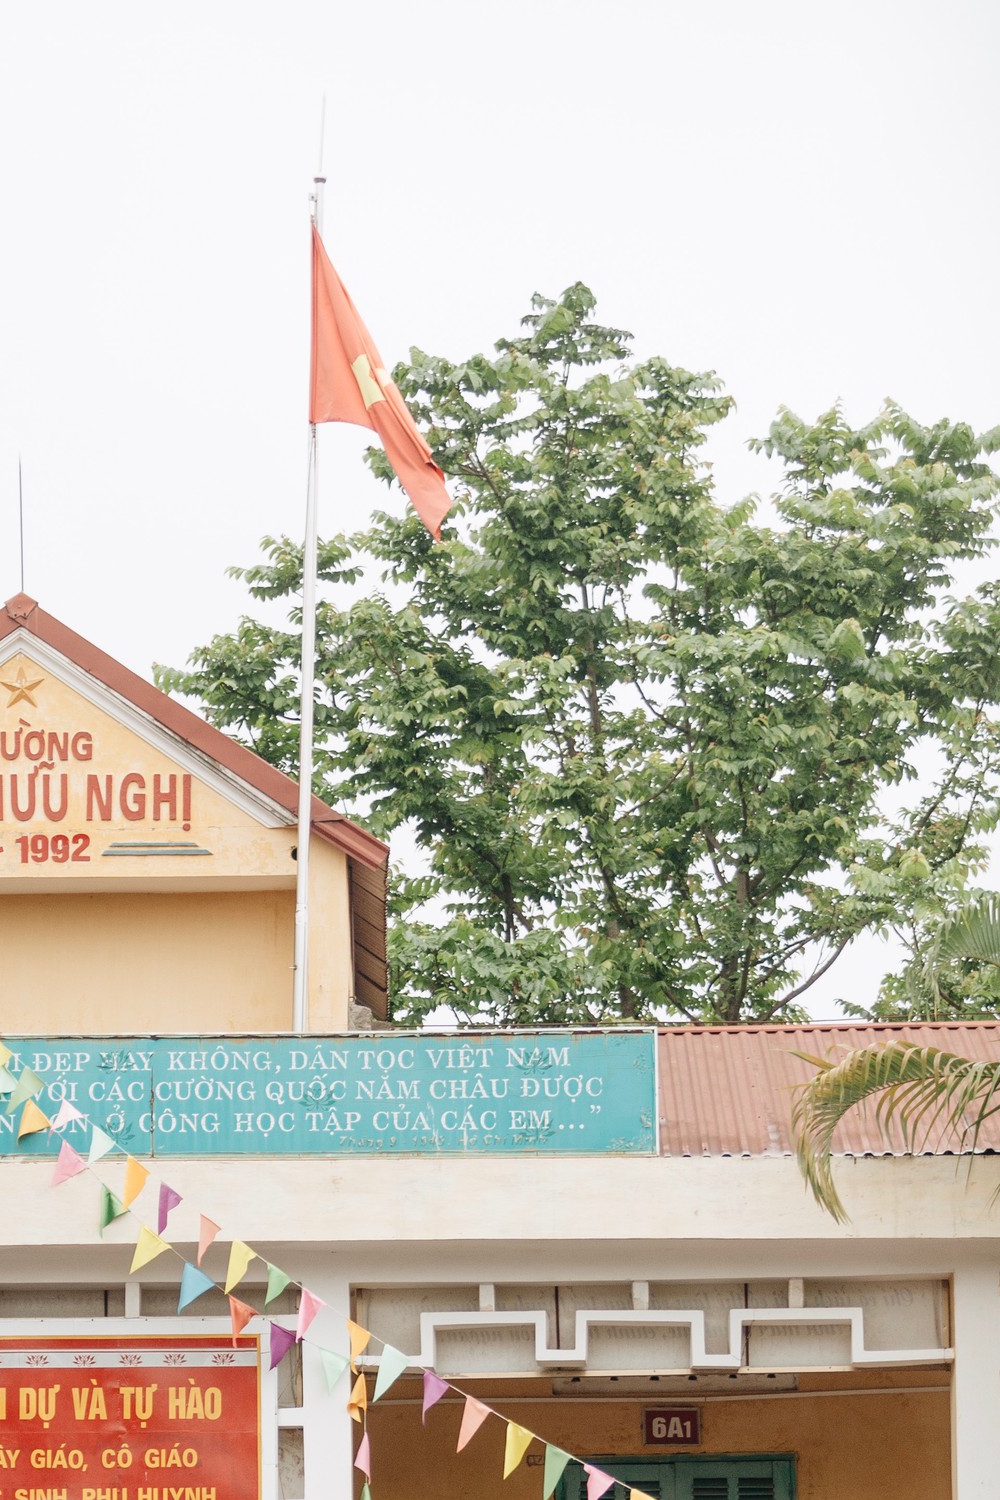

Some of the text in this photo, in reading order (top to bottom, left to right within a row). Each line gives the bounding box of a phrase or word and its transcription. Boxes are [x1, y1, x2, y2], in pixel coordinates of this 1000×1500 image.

[86, 773, 192, 831] NGHỊ
[32, 1052, 91, 1075] ĐẸP
[100, 1051, 154, 1072] HAY
[167, 1045, 281, 1074] KHÔNG,
[426, 1043, 494, 1074] VIỆT
[505, 1047, 571, 1068] NAM
[88, 1076, 145, 1102] CÁC
[155, 1075, 256, 1101] CƯỜNG
[265, 1073, 346, 1104] QUỐC
[355, 1075, 420, 1100] NĂM
[429, 1073, 509, 1100] CHÂU
[520, 1074, 603, 1103] ĐƯỢC
[139, 1108, 220, 1133] CÔNG
[234, 1112, 295, 1138] HỌC
[306, 1107, 362, 1136] TẬP
[373, 1104, 430, 1130] CỦA
[441, 1104, 497, 1130] CÁC
[19, 1384, 60, 1428] DỰ
[72, 1379, 107, 1420] VÀ
[120, 1384, 157, 1428] TỰ
[169, 1378, 222, 1420] HÀO
[652, 1417, 691, 1438] 6A1
[31, 1443, 88, 1471] GIÁO,
[101, 1443, 133, 1468] CÔ
[144, 1443, 198, 1468] GIÁO
